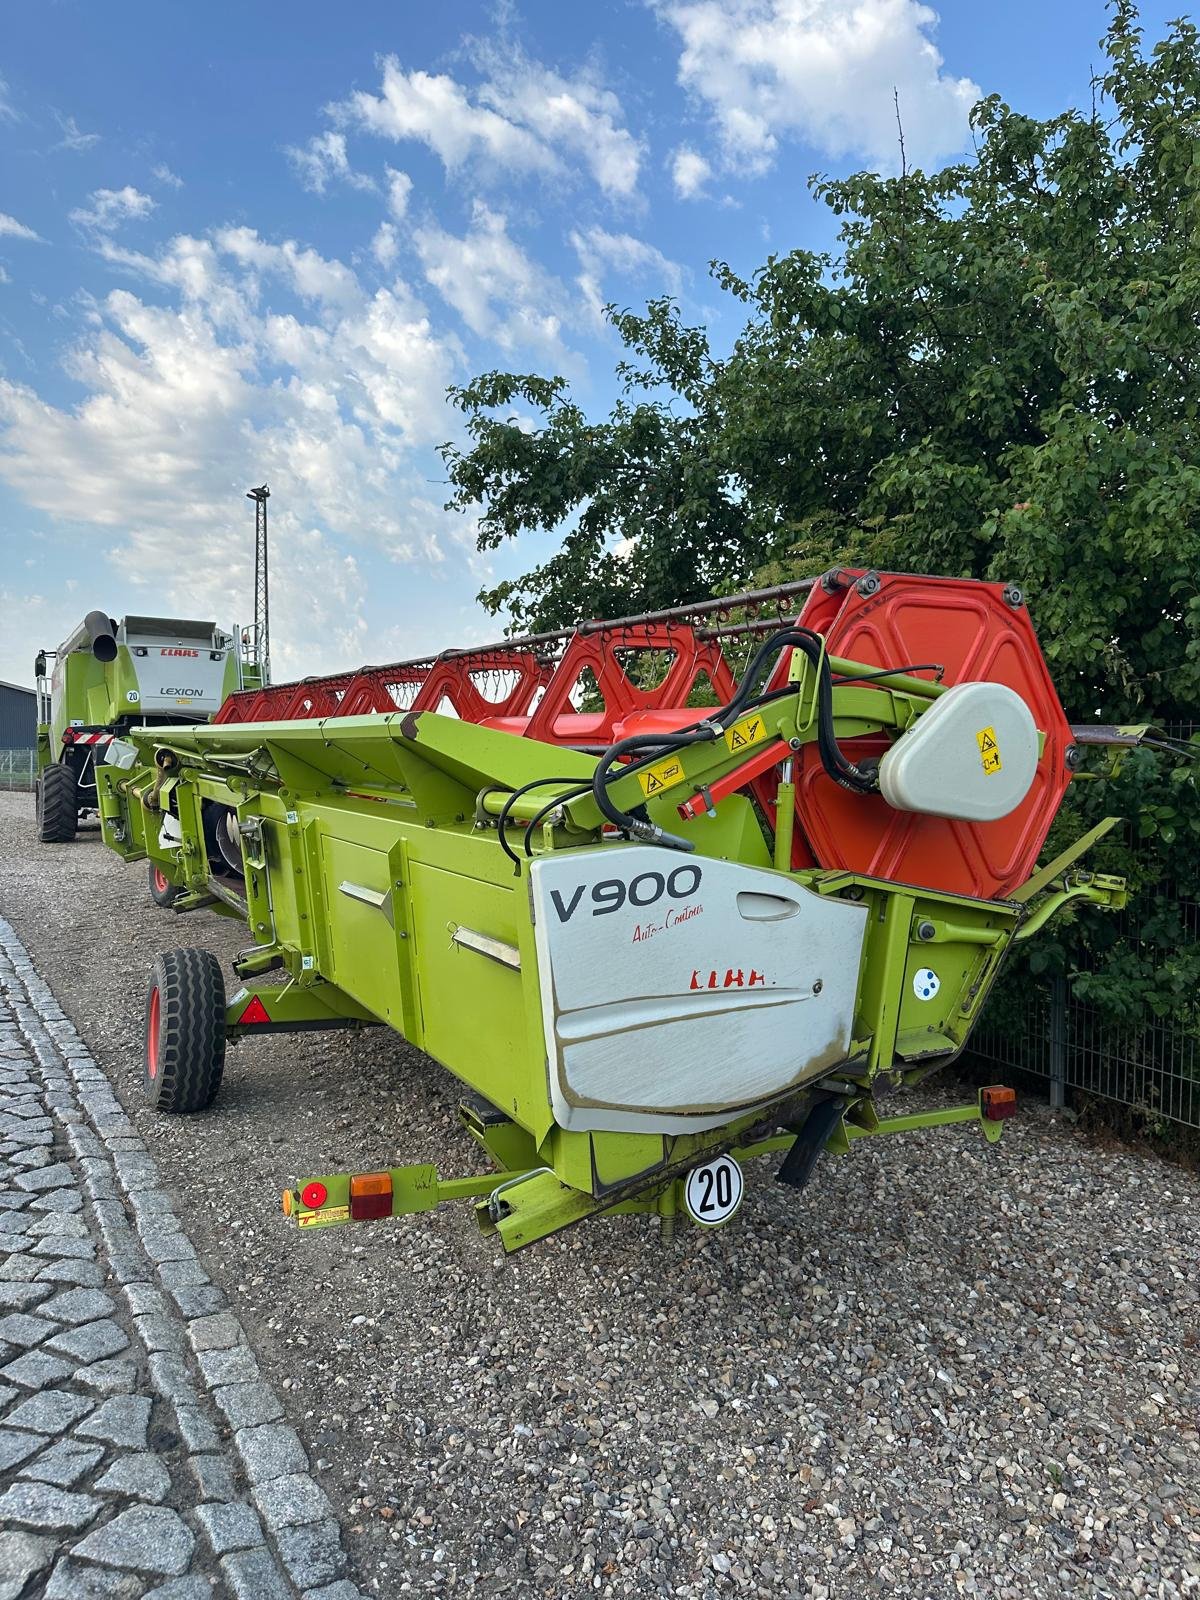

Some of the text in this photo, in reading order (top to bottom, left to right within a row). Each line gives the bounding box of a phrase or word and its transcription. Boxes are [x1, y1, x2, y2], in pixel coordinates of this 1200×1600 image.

[160, 648, 199, 658] CLAAS
[128, 691, 138, 701] 20
[160, 687, 204, 697] LEXION
[549, 864, 703, 923] V900
[698, 1164, 732, 1213] 20
